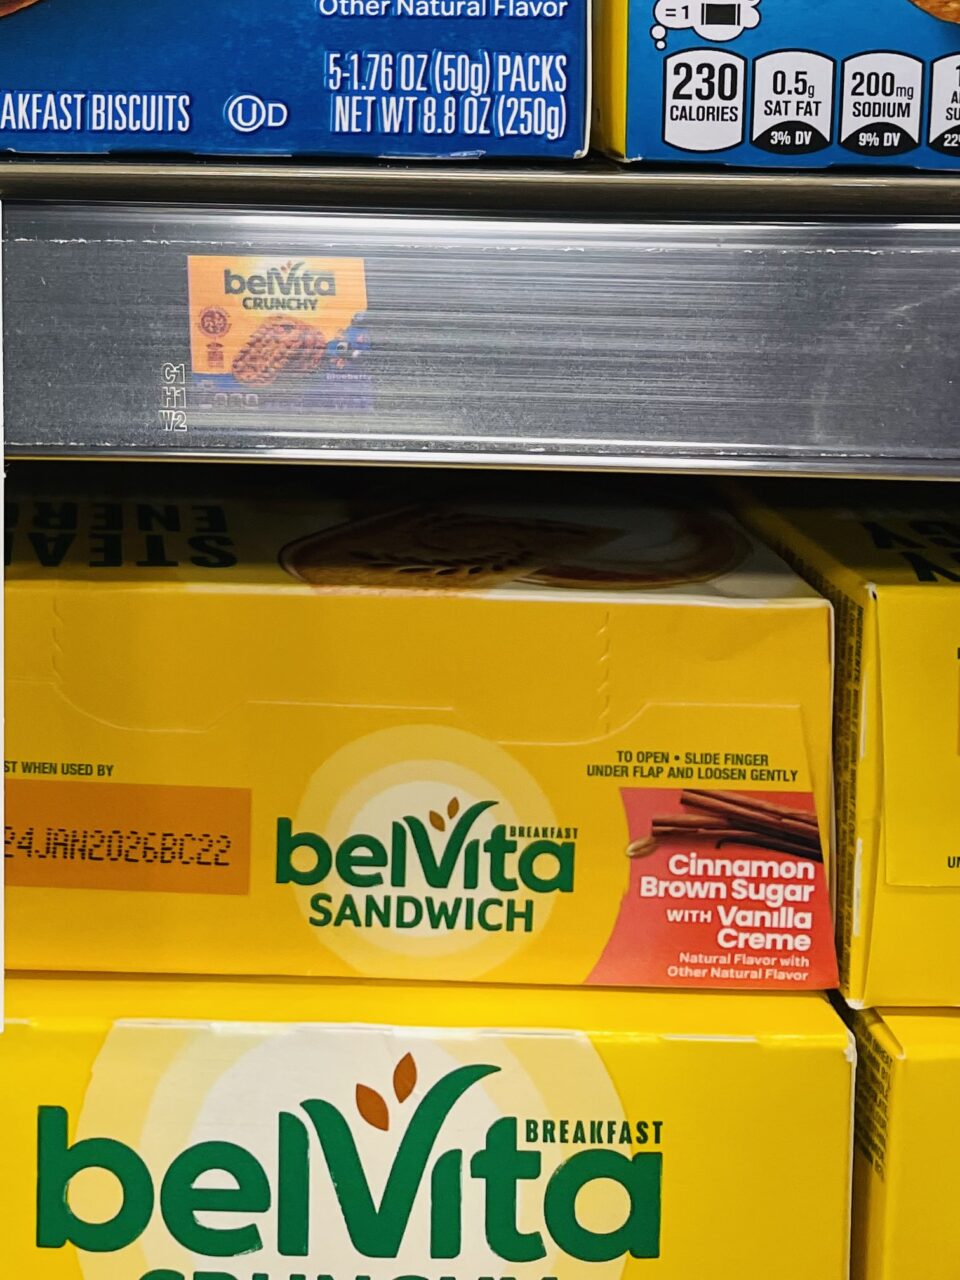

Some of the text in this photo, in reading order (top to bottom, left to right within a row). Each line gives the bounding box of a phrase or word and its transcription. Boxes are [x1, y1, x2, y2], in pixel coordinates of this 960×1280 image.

[329, 52, 567, 96] 5-1.76 OZ (50g) PACKS
[672, 62, 738, 102] 230
[92, 93, 191, 132] BISCUITS
[336, 95, 567, 140] NET WT 8.8 OZ (250g)
[669, 105, 739, 123] CALORIES
[224, 261, 337, 296] belVita
[242, 297, 318, 311] CRUNCHY
[275, 800, 575, 893] belVita
[509, 825, 578, 840] BREAKFAST
[668, 852, 815, 880] Cinnamon
[640, 875, 815, 908] Brown Sugar
[309, 893, 533, 933] SANDWICH
[666, 905, 812, 929] WITH Vanilla
[716, 928, 811, 951] Creme
[525, 1119, 663, 1146] BREAKFAST
[36, 1065, 663, 1263] belVita
